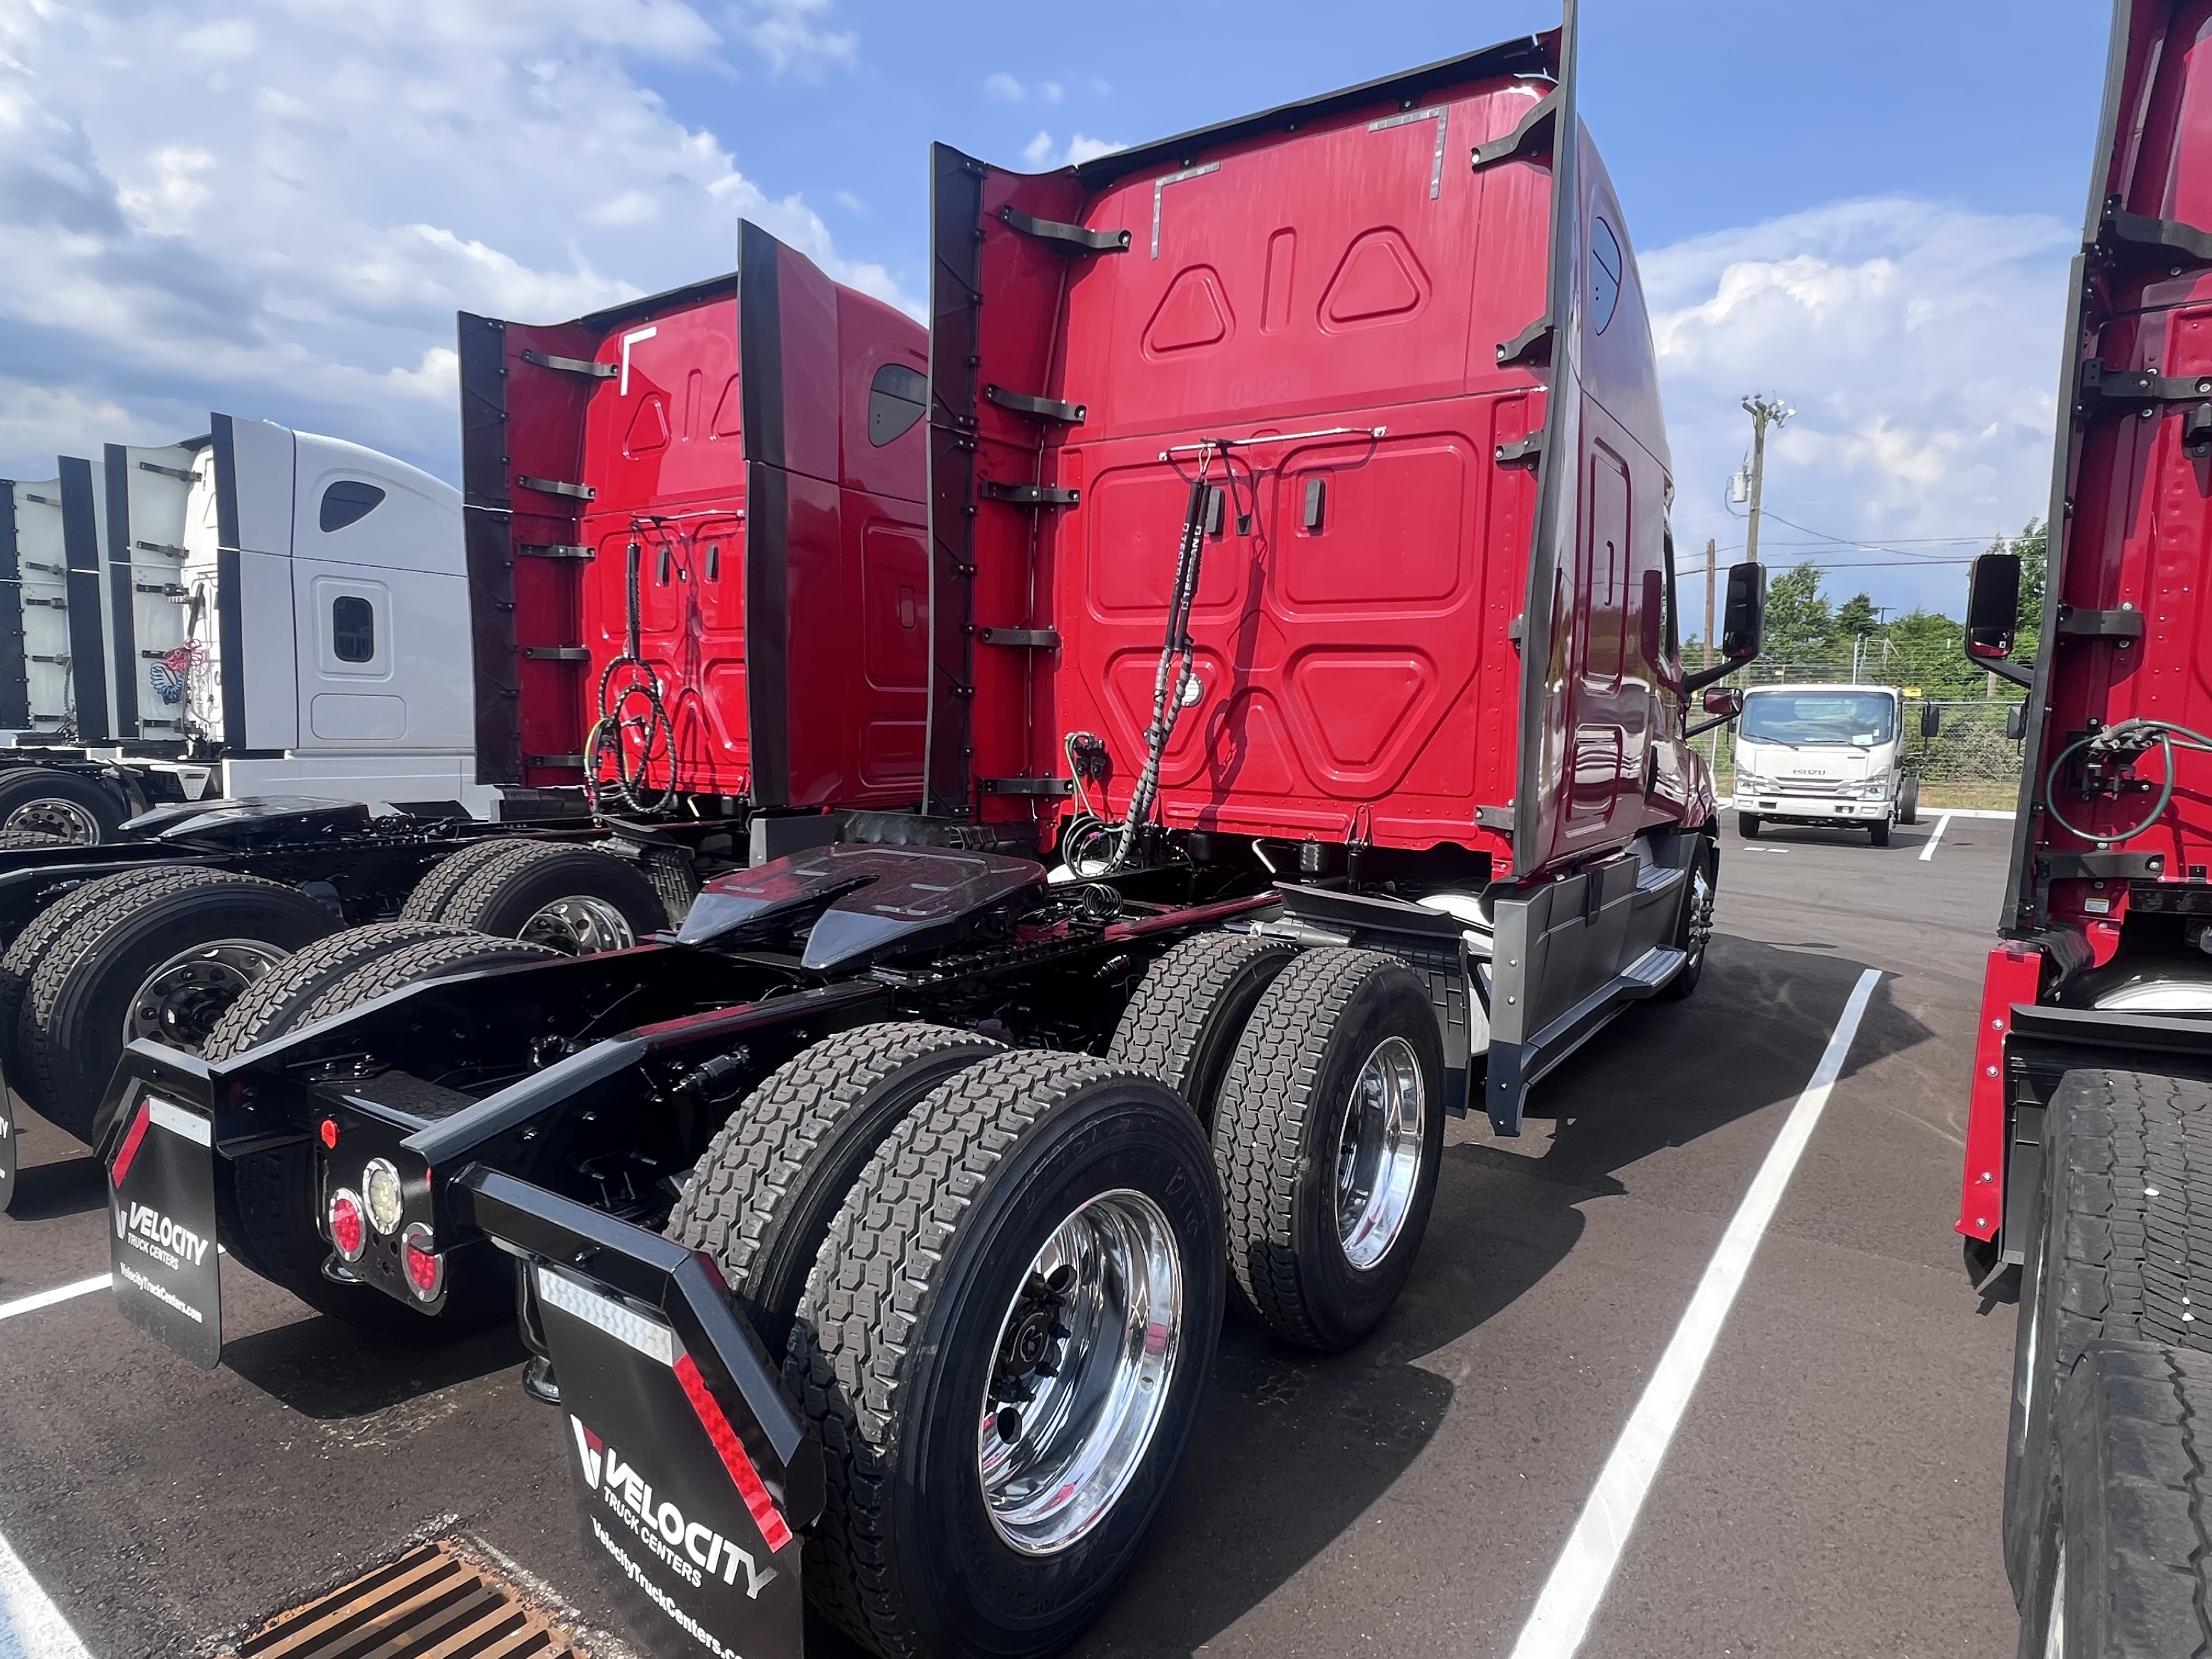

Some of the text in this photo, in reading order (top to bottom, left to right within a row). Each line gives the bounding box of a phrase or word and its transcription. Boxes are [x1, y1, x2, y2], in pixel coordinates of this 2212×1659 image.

[1232, 376, 1292, 405] 0422
[127, 1232, 179, 1271] TRUCK CENTERS
[129, 1201, 208, 1266] VELOCITY
[120, 1262, 203, 1323] VelocityTruckCenters.com
[604, 1486, 703, 1588] TRUCK CENTERS
[606, 1447, 780, 1600] VELOCITY
[591, 1516, 744, 1659] VelocityTruckCenters.c
